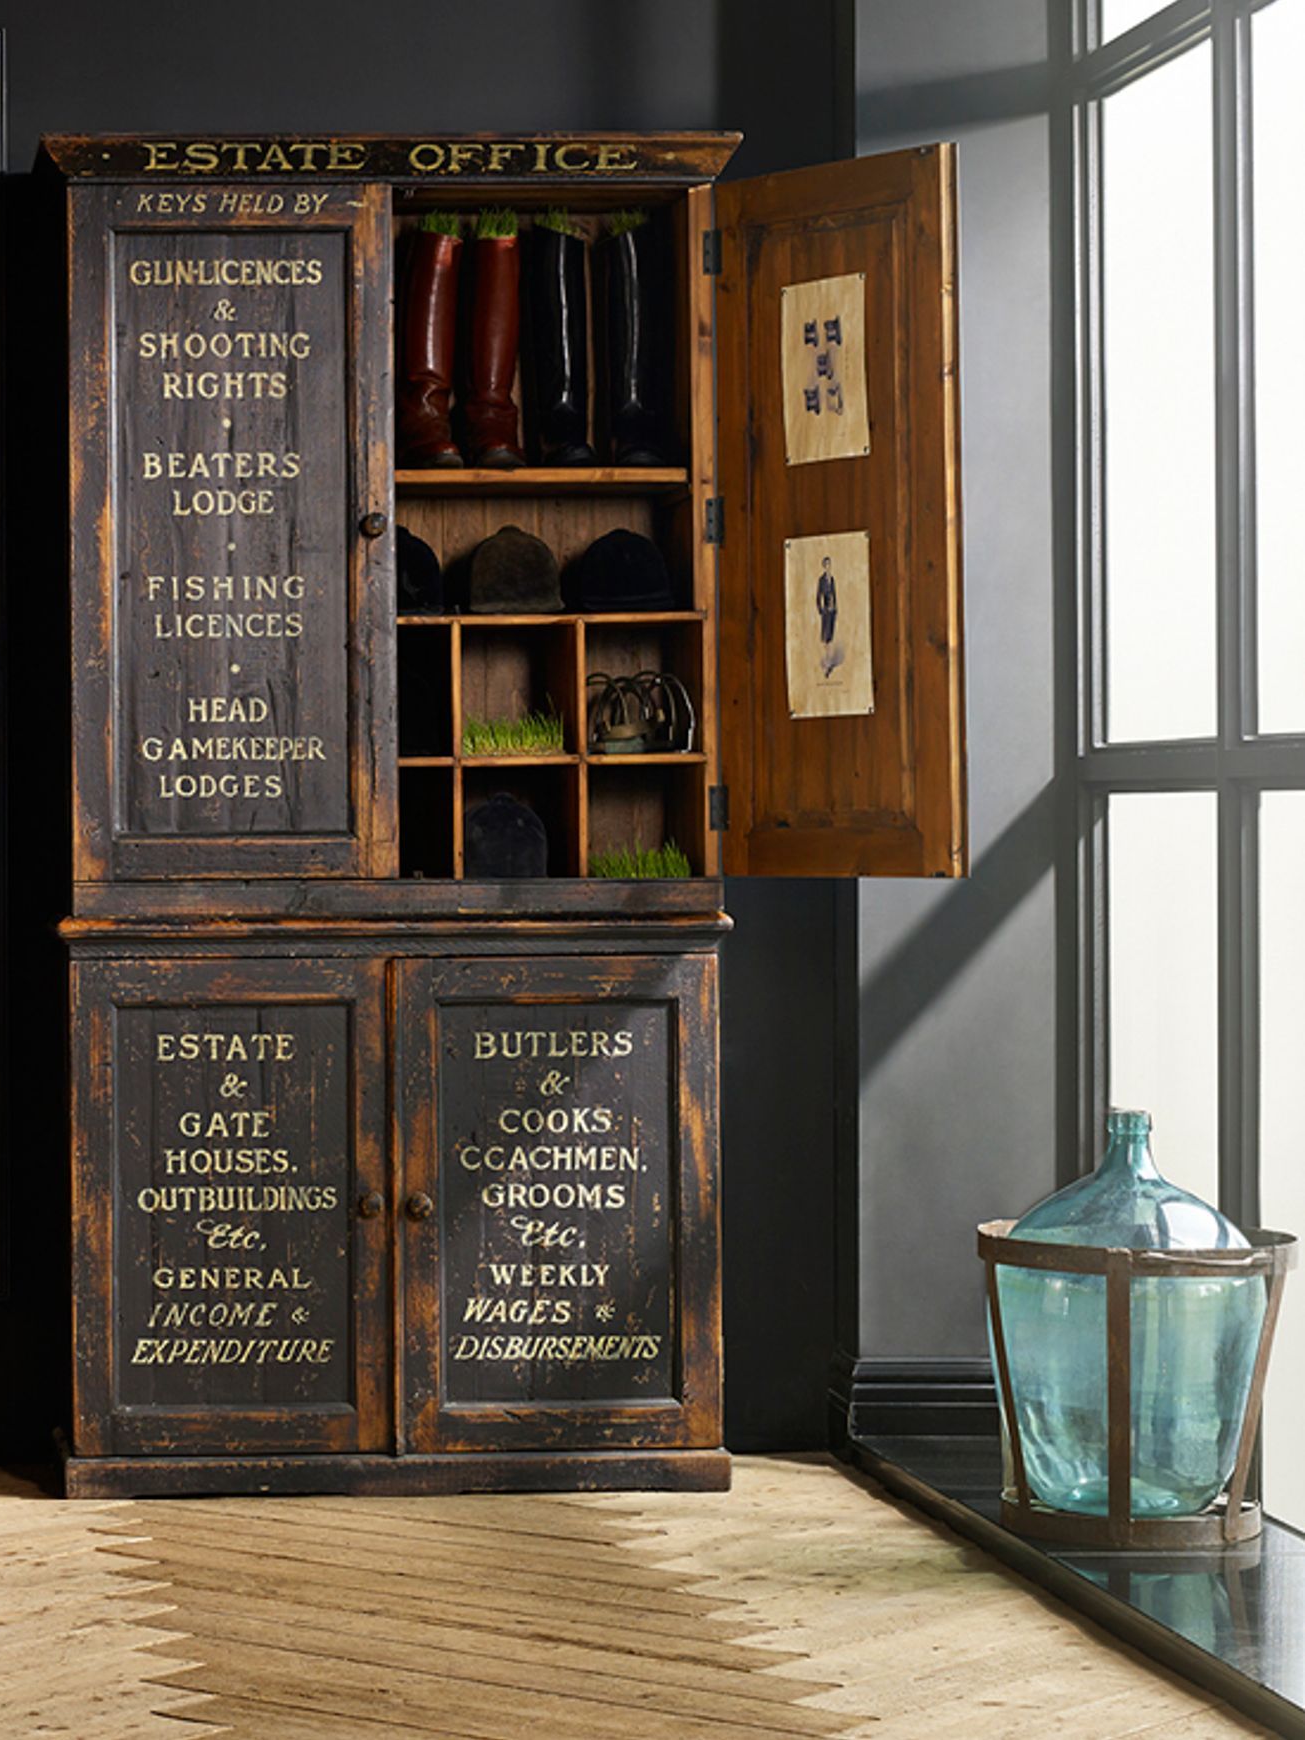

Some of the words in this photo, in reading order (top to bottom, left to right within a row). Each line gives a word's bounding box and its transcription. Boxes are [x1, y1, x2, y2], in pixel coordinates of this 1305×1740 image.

[142, 142, 367, 172] ESTATE
[408, 142, 638, 173] OFFICE
[137, 193, 208, 213] KEYS
[218, 193, 284, 213] HELD
[294, 193, 329, 214] BY
[213, 298, 237, 321] &
[139, 332, 311, 359] SHOOTING
[163, 371, 287, 400] RIGHTS
[142, 452, 301, 480] BEATERS
[172, 490, 275, 517] LODGE
[147, 575, 306, 601] FISHING
[155, 613, 303, 638] LICENCES
[187, 697, 268, 723] HEAD
[141, 736, 326, 761] GAMEKEEPER
[159, 775, 283, 799] LODGES
[156, 1034, 295, 1062] ESTATE
[474, 1031, 633, 1060] BUTLERS
[220, 1073, 247, 1098] &
[540, 1070, 570, 1097] &
[179, 1112, 271, 1139] GATE
[499, 1108, 612, 1134] COOKS
[137, 1186, 338, 1213] OUTBUILDINGS
[482, 1184, 626, 1209] GROOMS
[153, 1268, 312, 1290] GENERAL
[489, 1264, 610, 1288] WEEKLY
[147, 1303, 276, 1328] INCOME
[291, 1307, 309, 1325] &
[463, 1299, 571, 1325] WAGES
[595, 1303, 616, 1321] &
[131, 1339, 335, 1364] EXPENDITURE
[454, 1335, 661, 1361] DISBURSEMENTS
